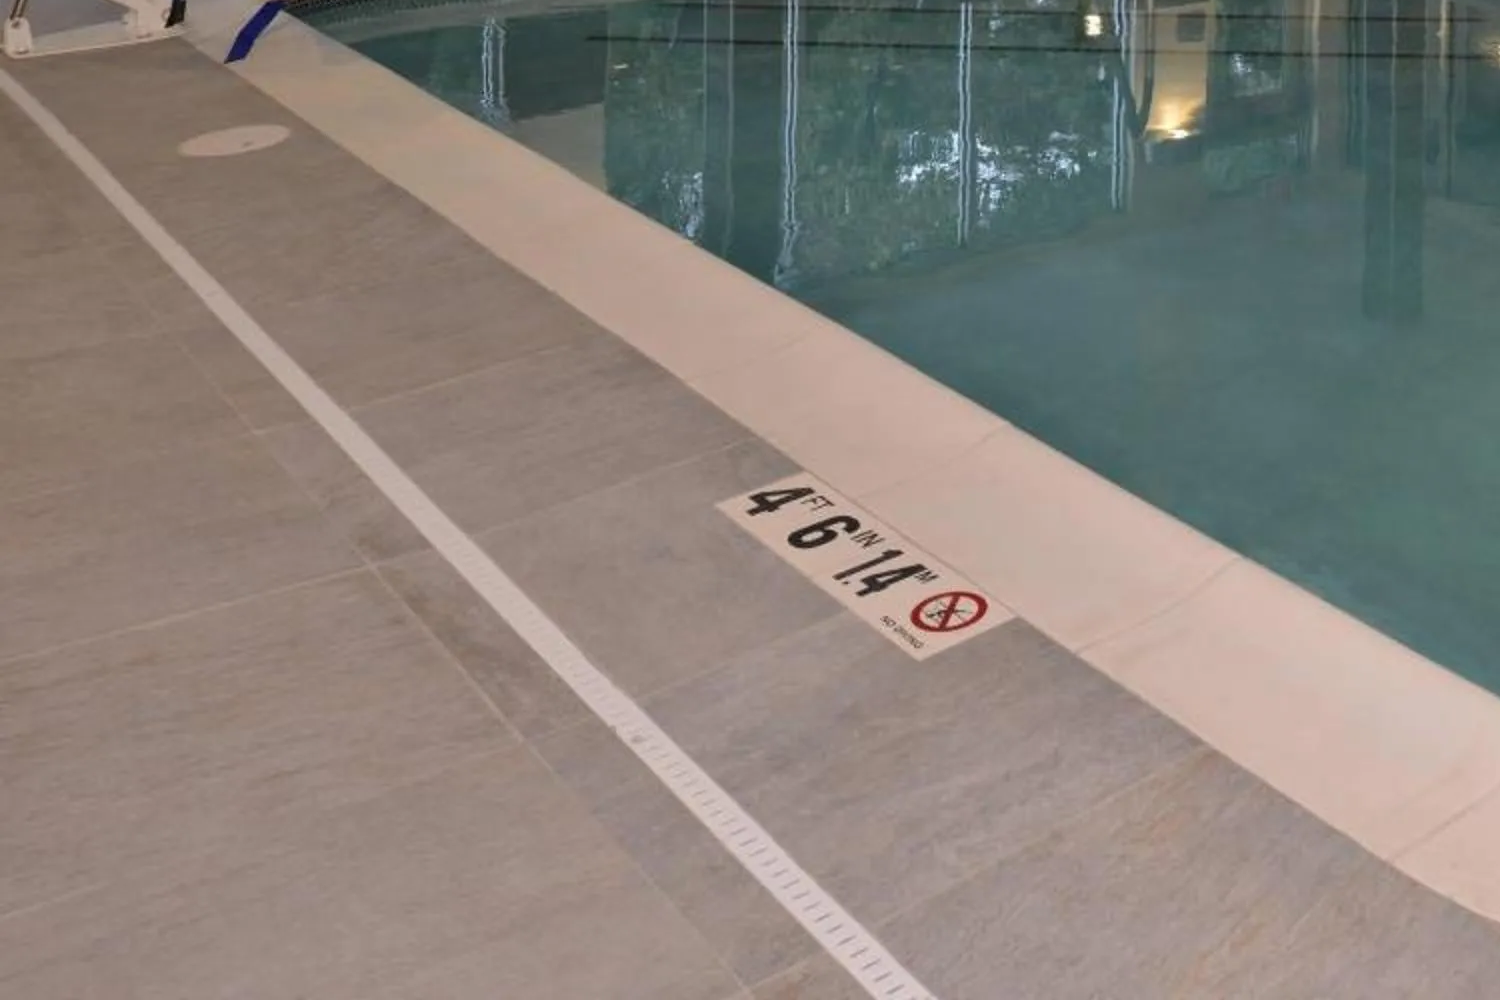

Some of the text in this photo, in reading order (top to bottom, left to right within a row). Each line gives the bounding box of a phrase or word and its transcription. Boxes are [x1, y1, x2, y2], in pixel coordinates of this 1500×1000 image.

[746, 486, 816, 517] 4
[801, 495, 836, 511] FT
[787, 515, 861, 549] 6
[850, 529, 886, 549] IN
[831, 549, 927, 597] 1.4
